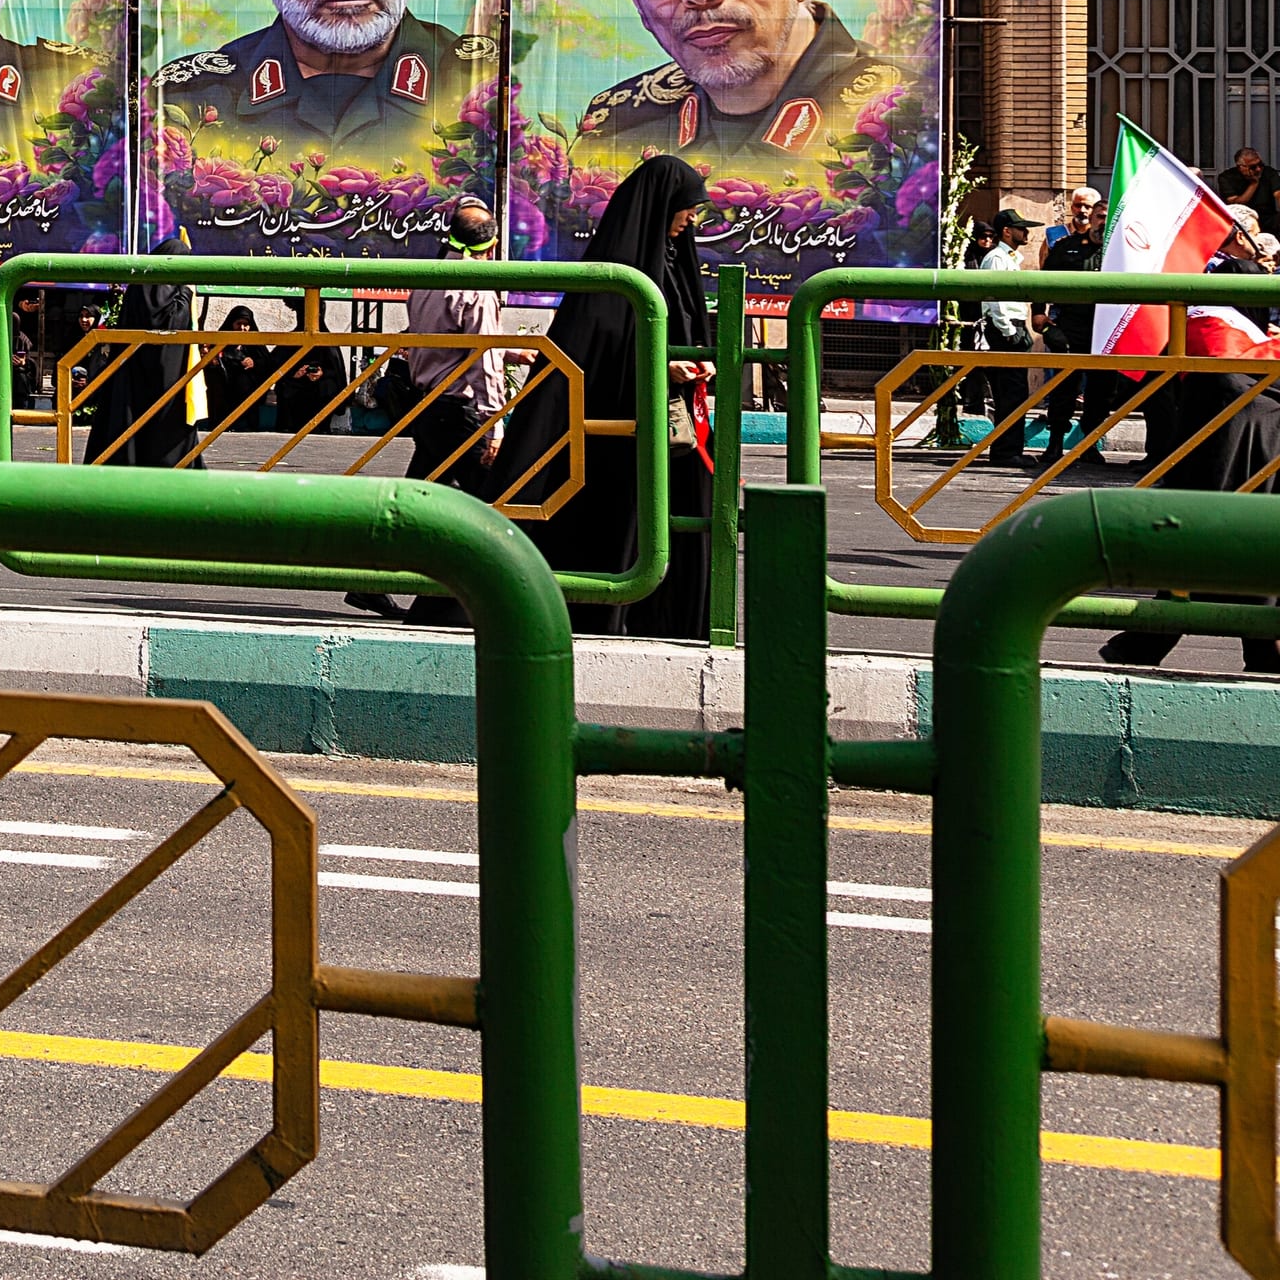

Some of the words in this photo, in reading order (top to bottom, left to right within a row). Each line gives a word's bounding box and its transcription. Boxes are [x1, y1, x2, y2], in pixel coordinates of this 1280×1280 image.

[34, 193, 60, 232] سپاه
[261, 193, 365, 242] شهیدان
[348, 193, 391, 240] لشکر
[391, 209, 435, 239] مهدی
[736, 205, 781, 254] لشکر
[782, 222, 831, 253] مهدی
[830, 225, 857, 263] سپاه
[749, 267, 792, 290] سپهبد
